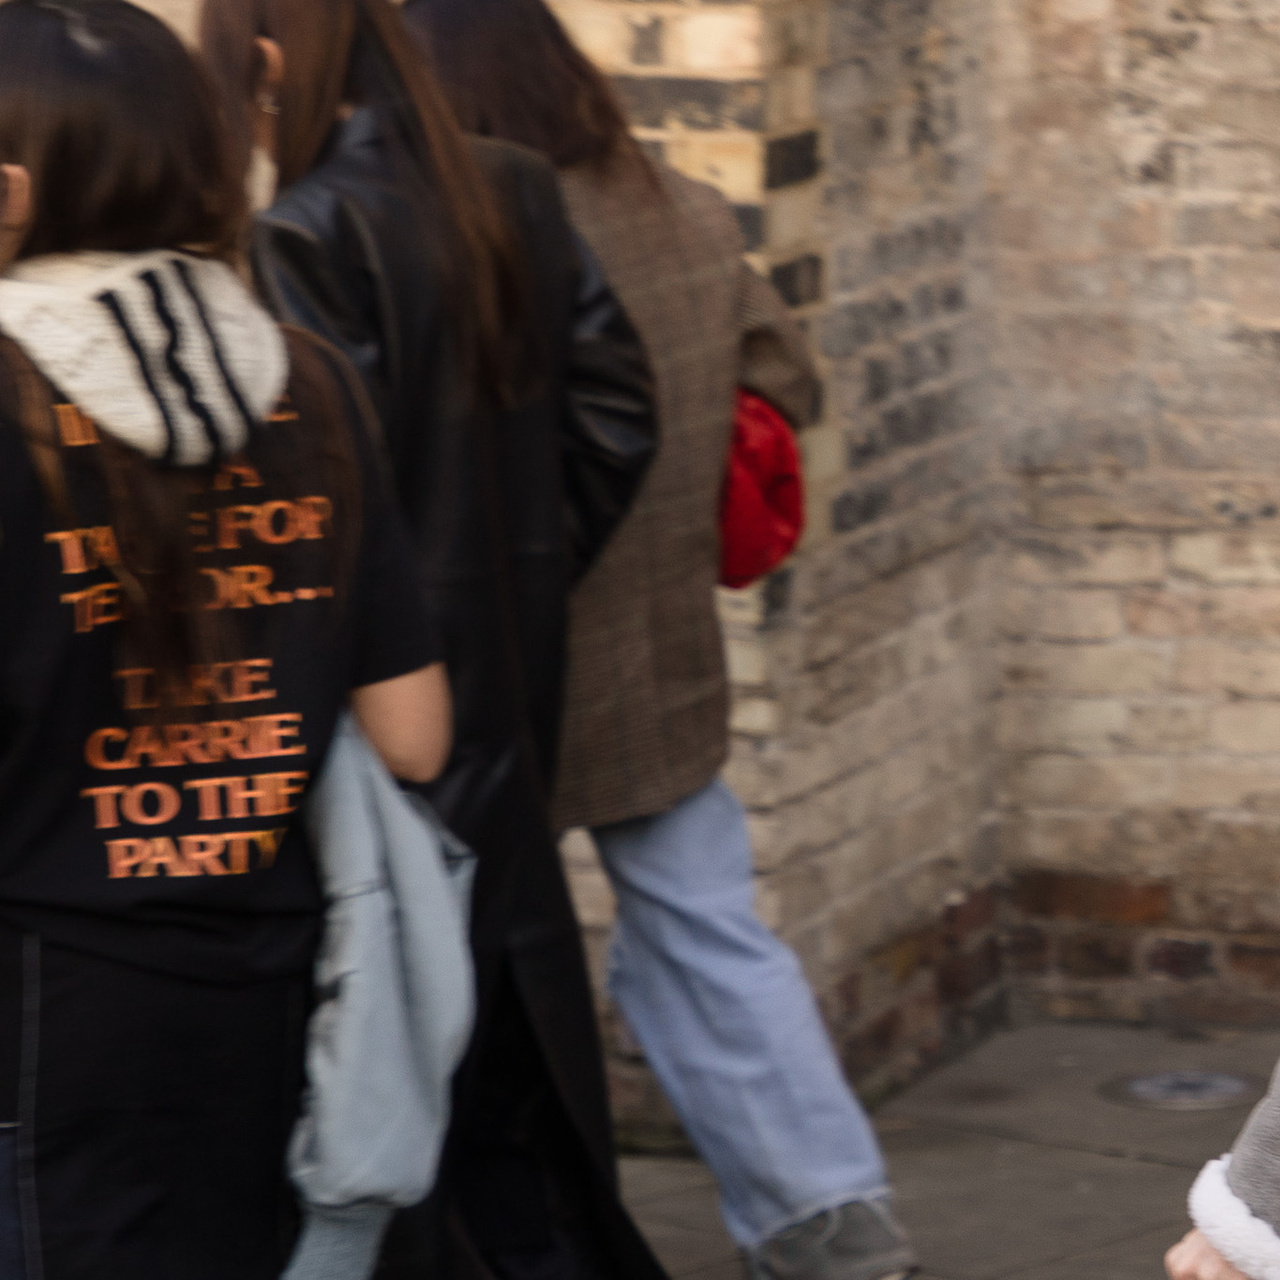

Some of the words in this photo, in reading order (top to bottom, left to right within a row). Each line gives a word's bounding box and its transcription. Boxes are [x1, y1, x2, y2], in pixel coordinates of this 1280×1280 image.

[84, 712, 307, 770] CARRIE
[80, 781, 182, 829] TO
[182, 771, 309, 821] THE
[104, 828, 288, 879] PARTY
